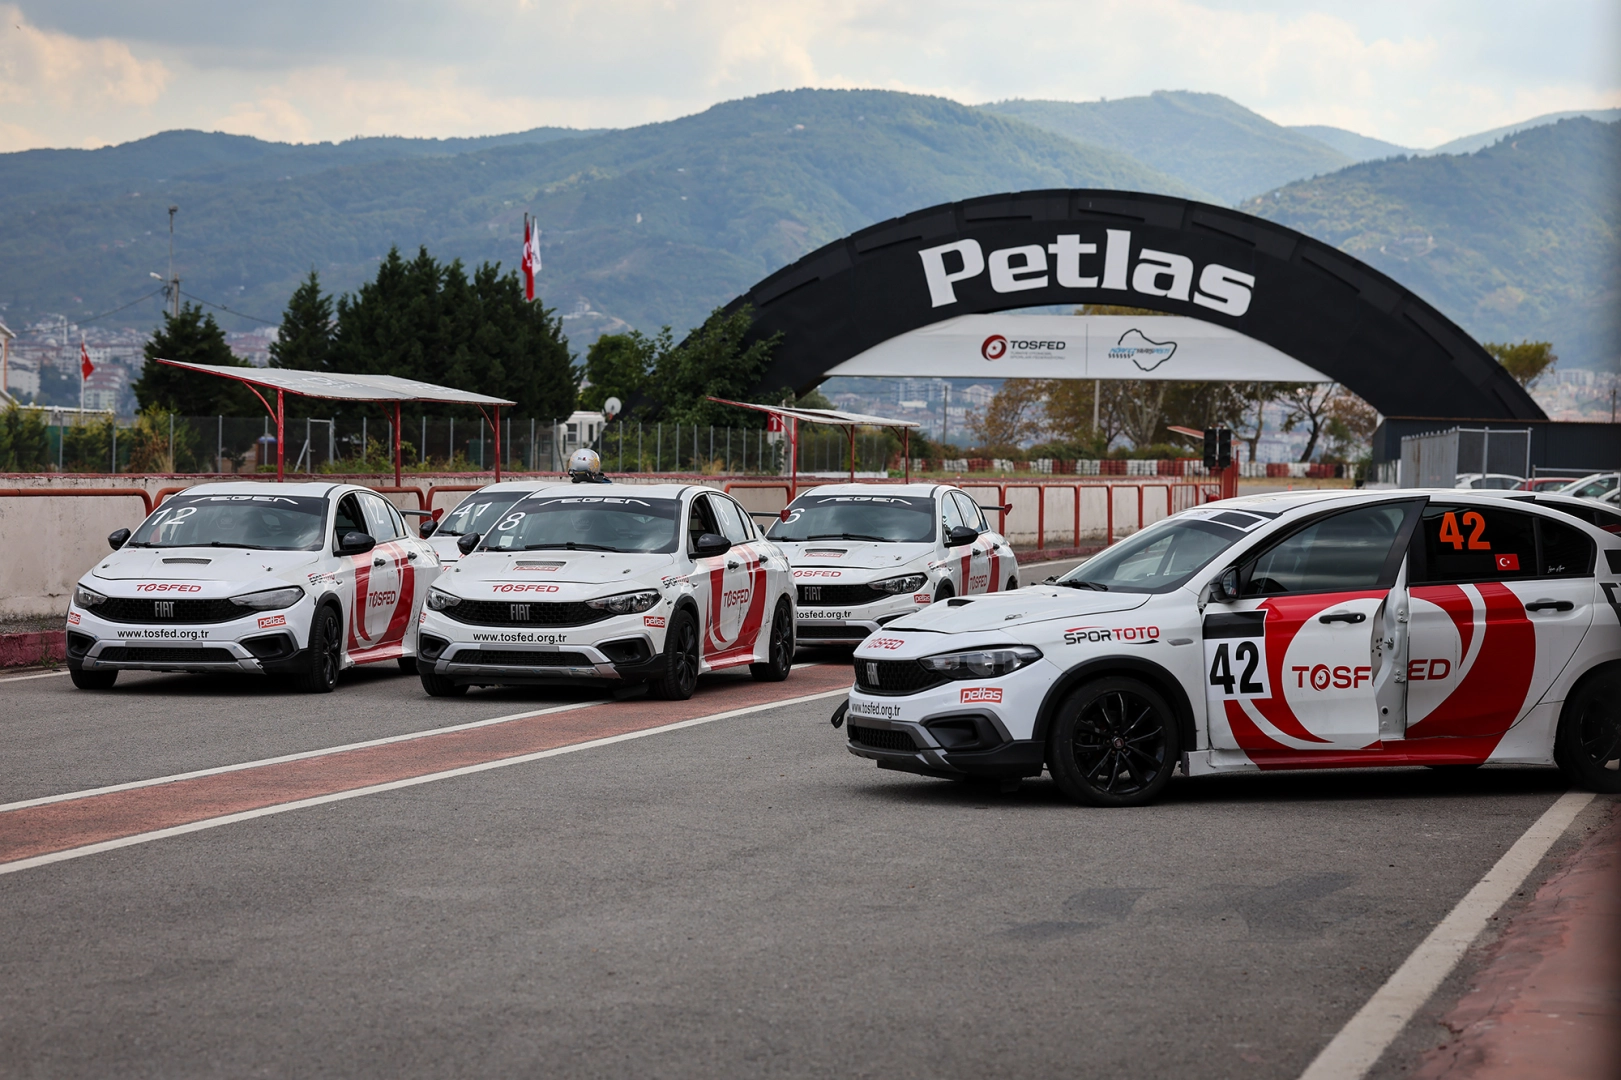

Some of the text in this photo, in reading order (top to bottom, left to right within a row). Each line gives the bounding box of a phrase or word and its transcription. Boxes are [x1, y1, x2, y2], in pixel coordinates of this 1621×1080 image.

[918, 229, 1255, 317] Petlas
[1010, 340, 1066, 350] TOSFED
[771, 417, 777, 430] 1
[151, 507, 197, 525] 12
[453, 502, 492, 518] 41
[498, 512, 526, 531] 8
[1439, 511, 1491, 549] 42
[793, 570, 841, 578] OSFED
[136, 584, 201, 593] TOSFED
[492, 584, 559, 593] TOSFED
[805, 586, 821, 600] FIAT
[369, 590, 396, 608] TOSFED
[724, 589, 750, 608] TOSFED
[155, 601, 174, 617] FIAT
[511, 604, 530, 620] FIAT
[259, 616, 285, 628] petlas
[645, 616, 665, 627] petlas
[117, 629, 209, 640] www.tosfed.org.tr
[473, 633, 567, 644] www.tosfed.org.tr
[1210, 641, 1264, 695] 42
[961, 688, 1001, 702] petlas
[852, 702, 901, 719] www.tosfed.org.tr
